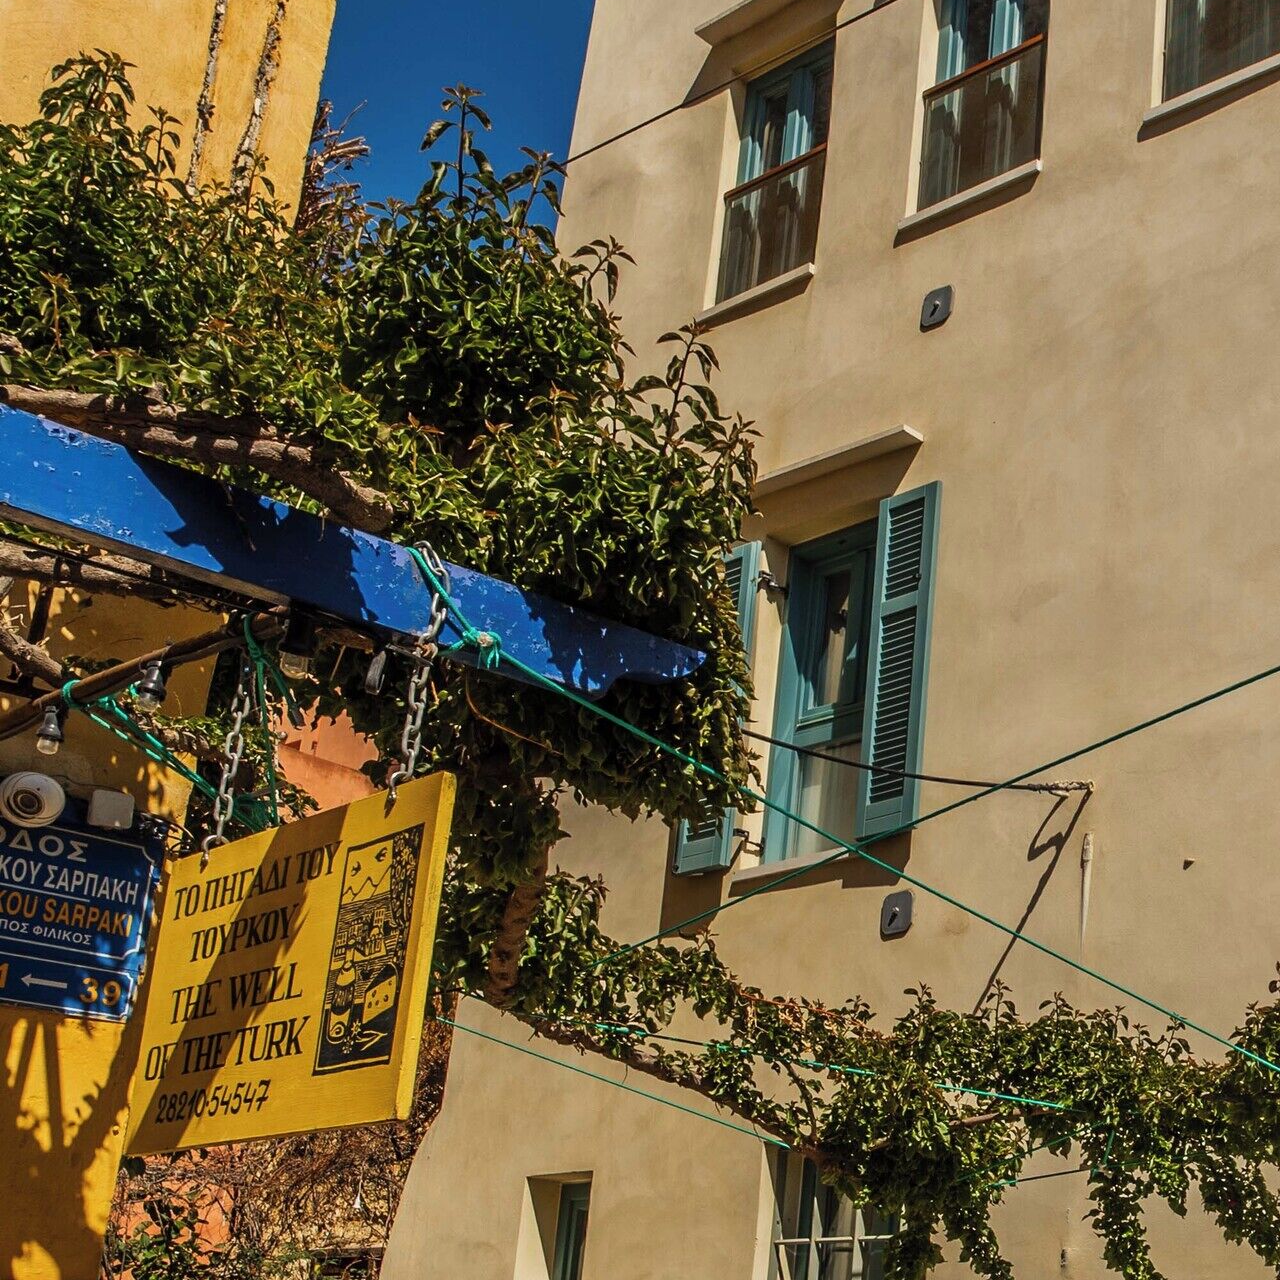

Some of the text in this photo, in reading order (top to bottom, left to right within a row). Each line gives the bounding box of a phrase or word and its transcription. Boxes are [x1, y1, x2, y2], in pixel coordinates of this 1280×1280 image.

[43, 864, 139, 906] ΣΑΡΠΑΚΗ
[173, 840, 343, 920] ΤΟ ΠΗΓΑΔΙ ΤΟΥ
[32, 925, 92, 945] ΦΙΛΙΚΟΣ
[43, 898, 133, 938] SARPAKI
[190, 903, 299, 962] ΤΟΥΡΚΟΥ
[80, 977, 121, 1006] 39
[172, 962, 303, 1024] THE WELL
[145, 1015, 311, 1081] OF THE TURK
